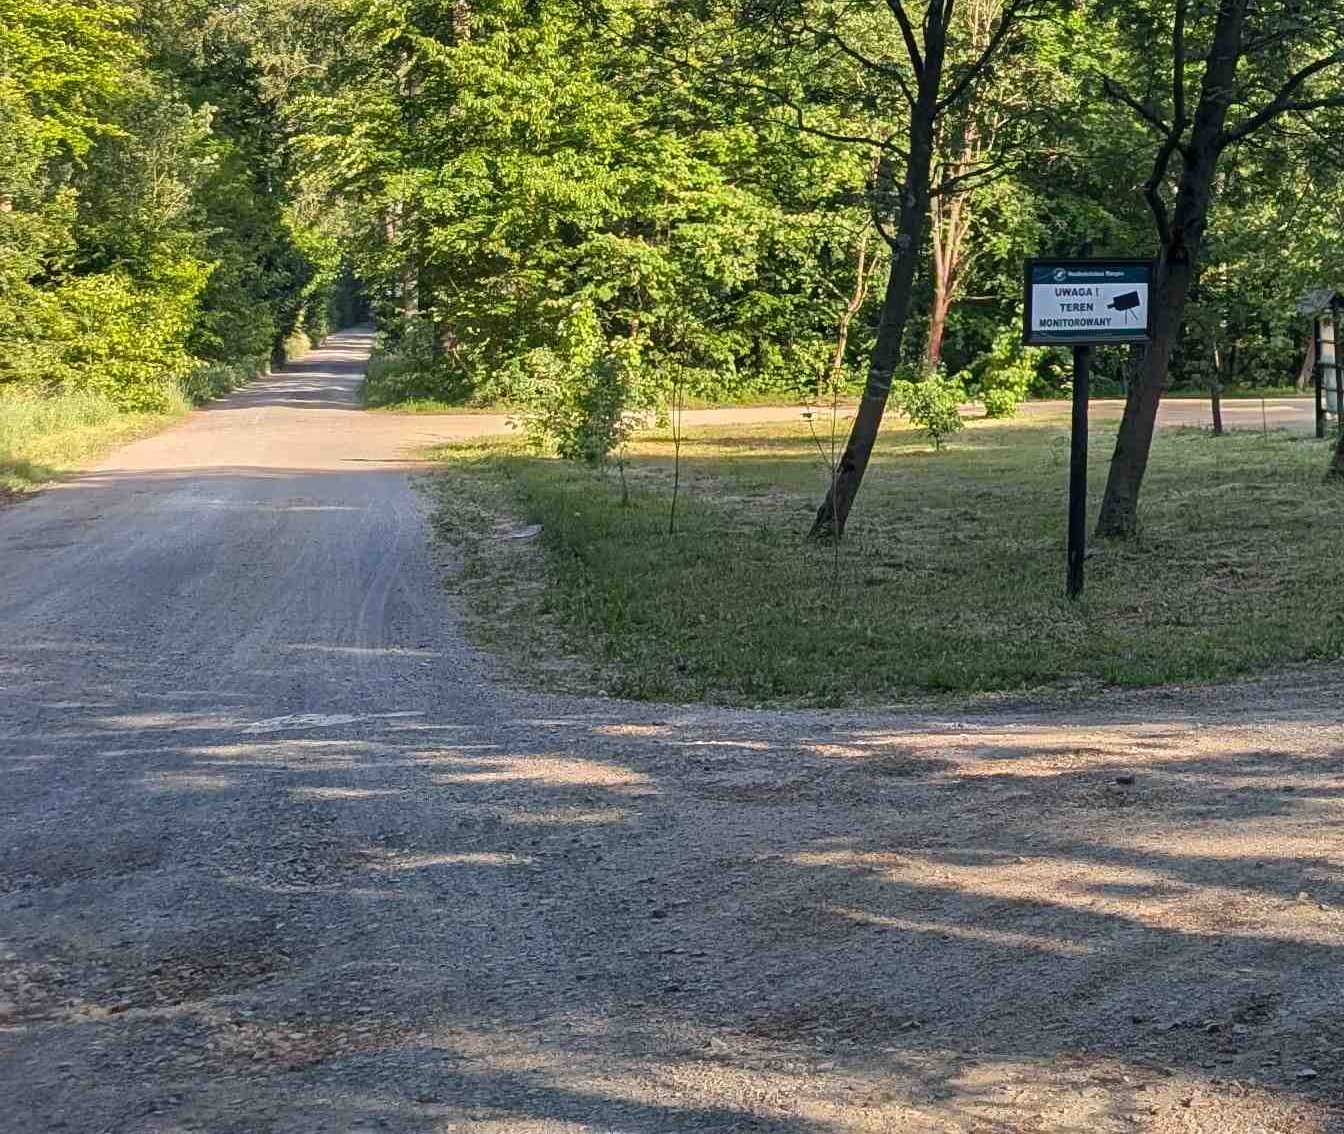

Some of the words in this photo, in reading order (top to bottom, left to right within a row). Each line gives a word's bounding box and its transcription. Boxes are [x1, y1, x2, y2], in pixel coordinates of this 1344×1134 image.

[1055, 287, 1093, 297] UWAGA
[1060, 303, 1094, 312] TEREN
[1040, 318, 1112, 328] MONITOROWANY
